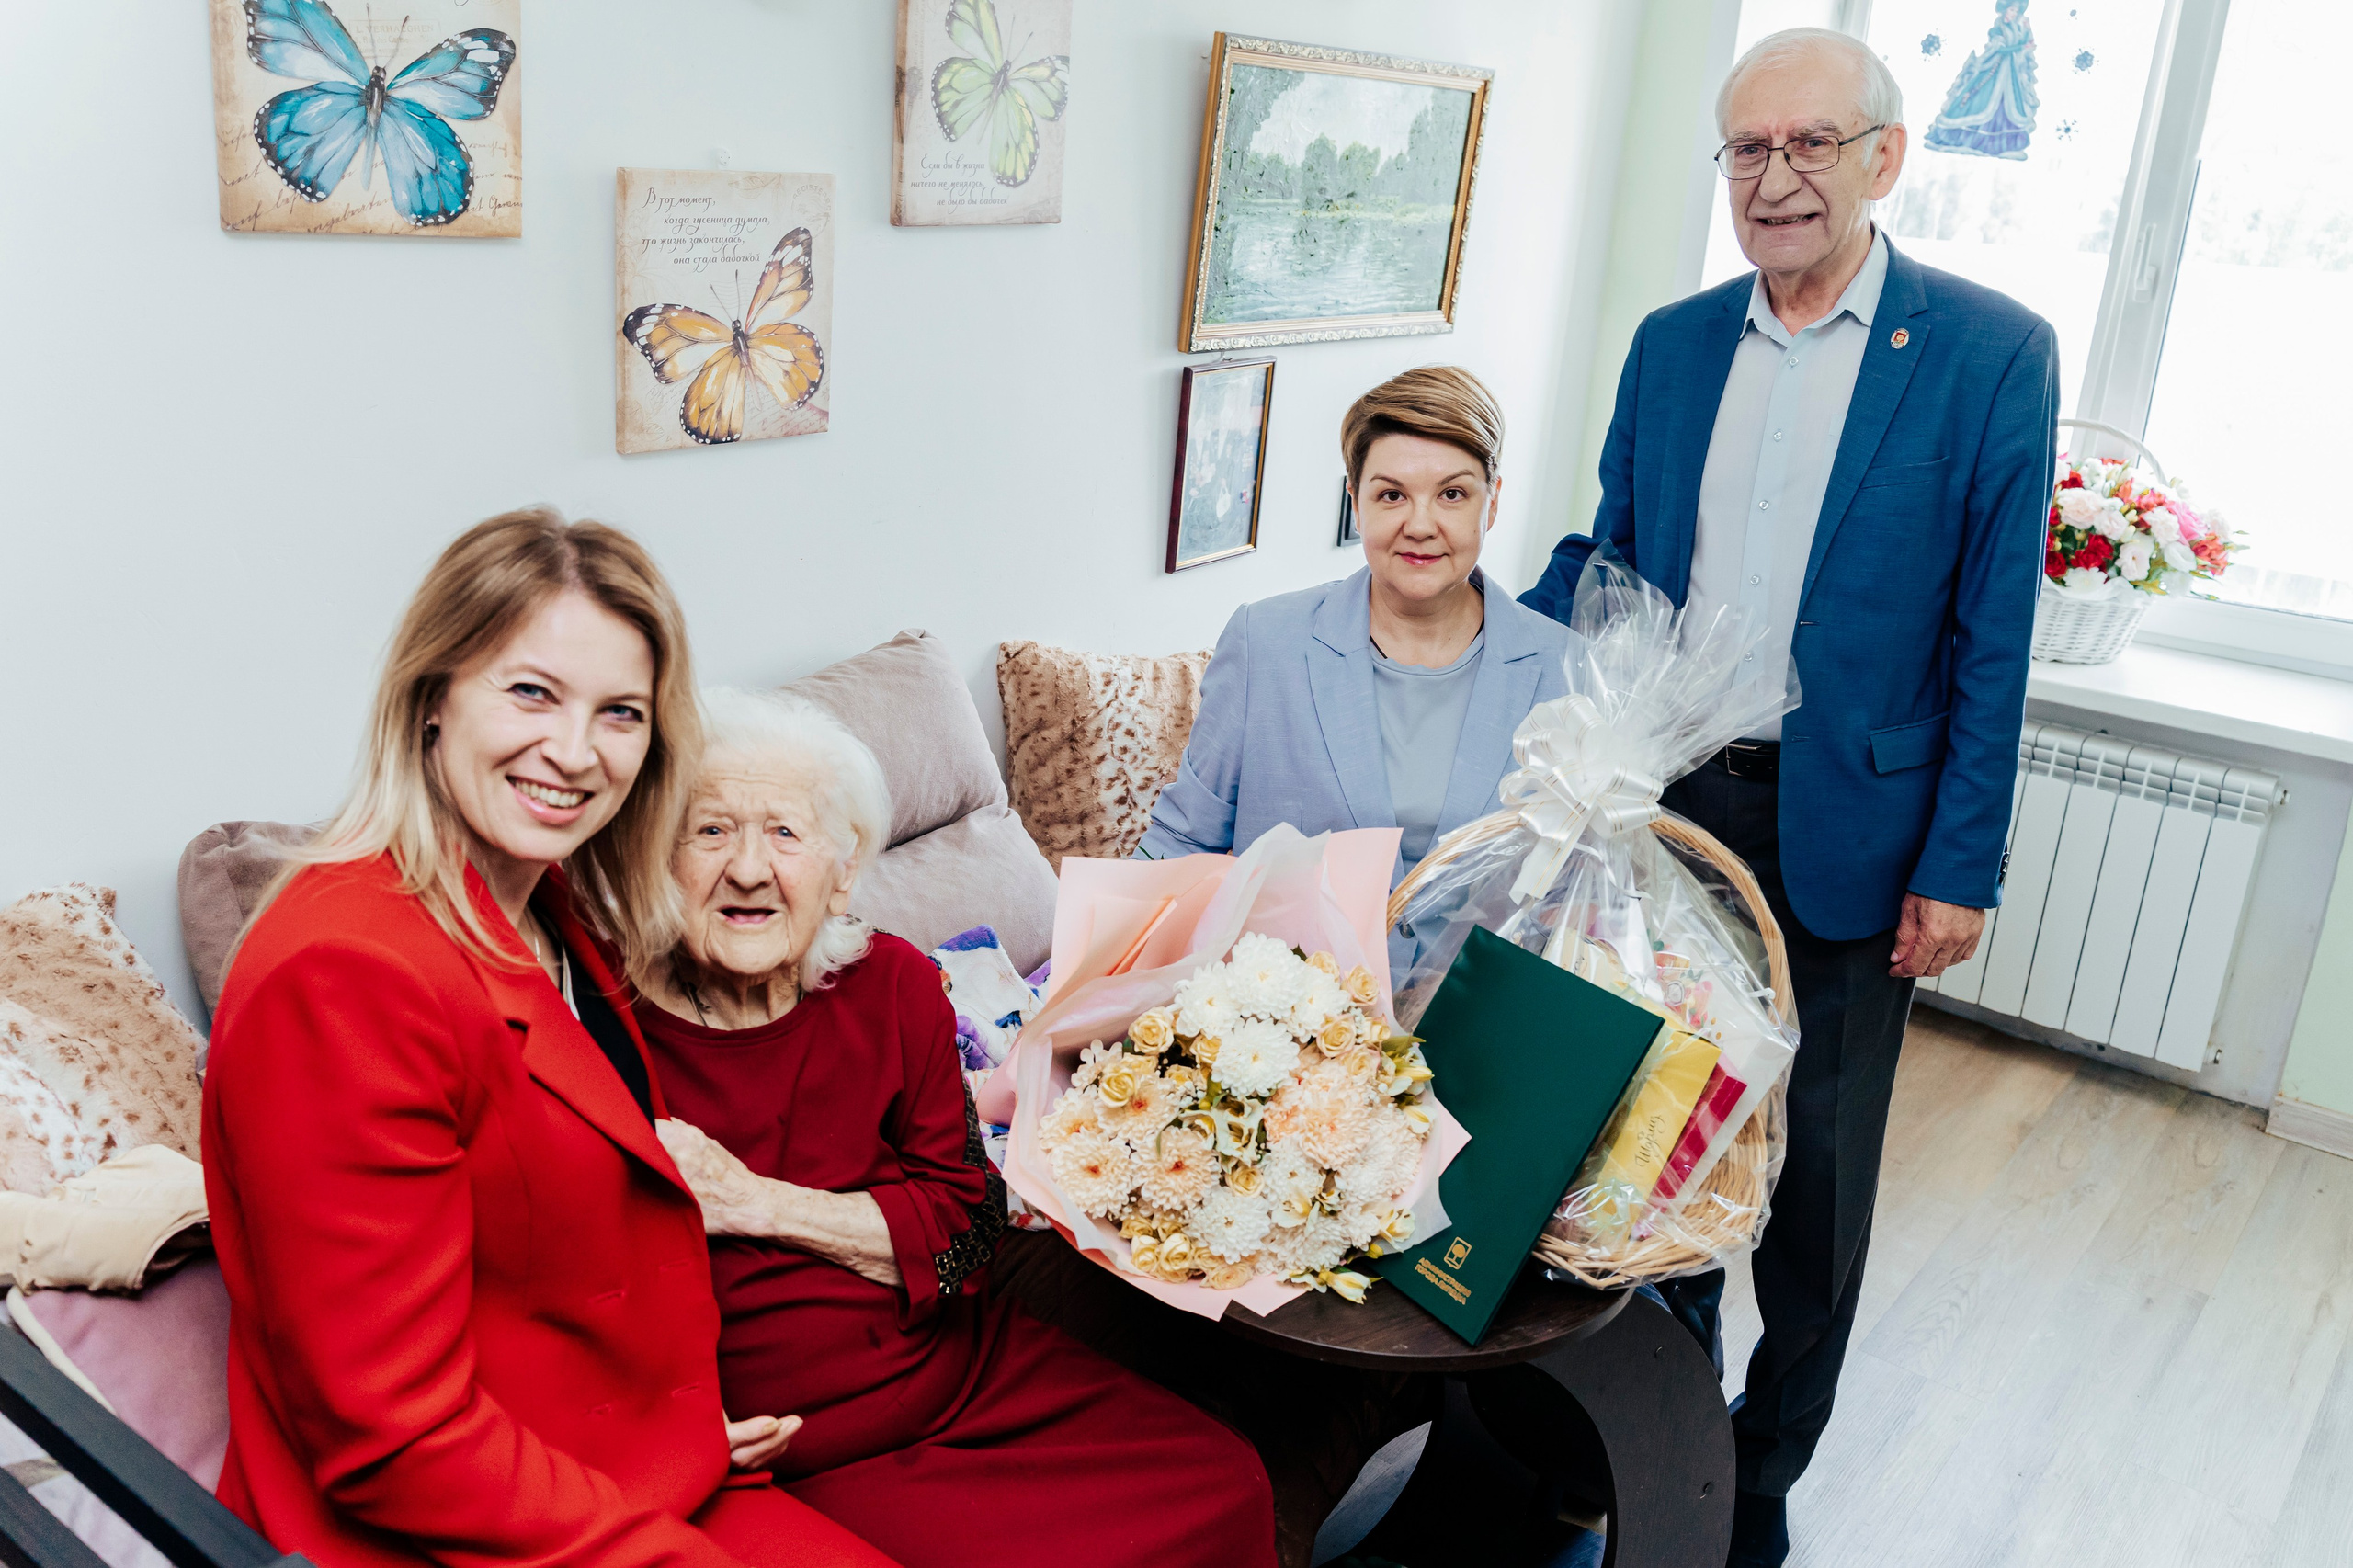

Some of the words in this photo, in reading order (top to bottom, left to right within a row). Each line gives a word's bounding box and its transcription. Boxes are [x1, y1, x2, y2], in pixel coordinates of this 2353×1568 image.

[920, 153, 941, 178] Если
[943, 151, 953, 169] бы
[962, 163, 985, 177] жизни
[910, 180, 937, 188] ничего
[938, 180, 948, 188] не
[642, 187, 657, 209] В
[654, 197, 676, 214] тот
[673, 197, 716, 213] момент,
[948, 187, 966, 214] было
[979, 187, 1009, 205] бабочек
[664, 214, 690, 235] когда
[686, 217, 733, 235] гусеница
[729, 216, 771, 236] думала,
[641, 237, 657, 255] что
[659, 237, 687, 254] жизнь
[686, 233, 745, 253] закончилась,
[673, 256, 690, 265] она
[693, 256, 718, 273] стала
[720, 244, 761, 263] бабочкой
